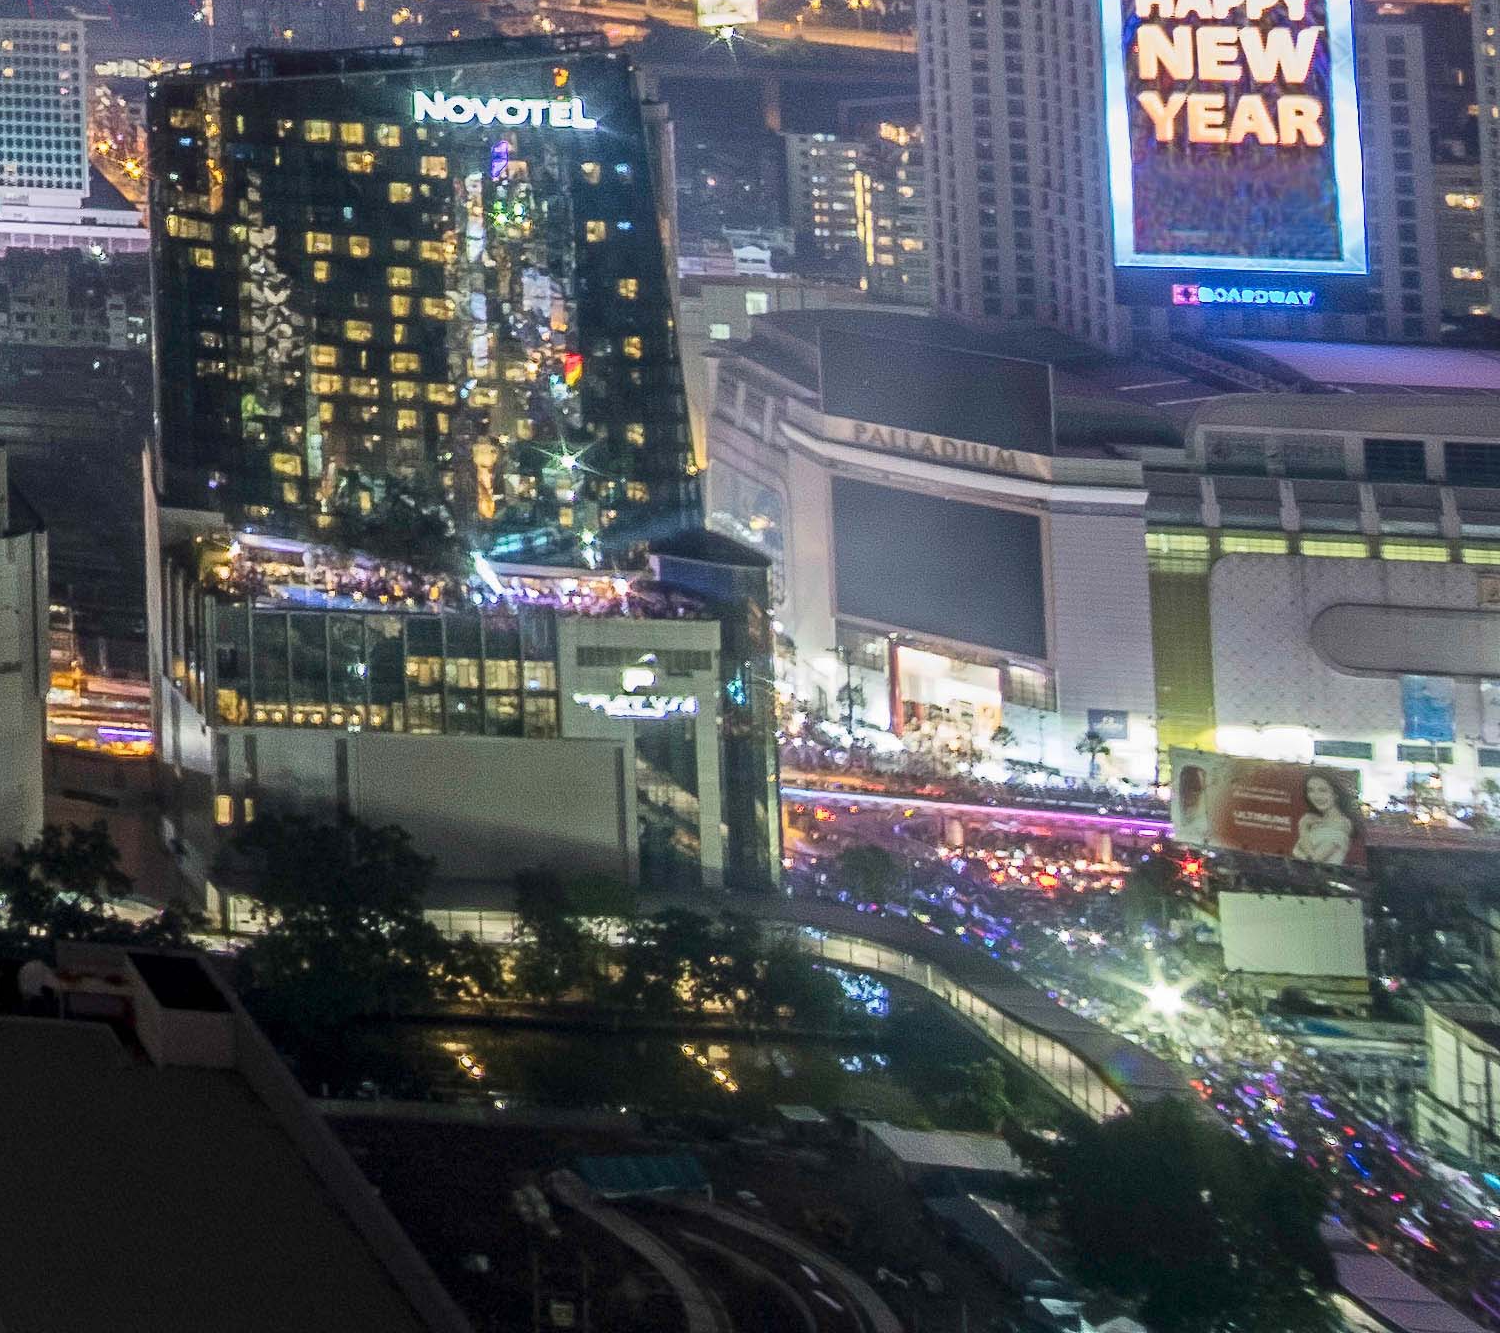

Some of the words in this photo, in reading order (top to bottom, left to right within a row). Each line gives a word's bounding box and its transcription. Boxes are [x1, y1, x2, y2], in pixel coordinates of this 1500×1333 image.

[1137, 24, 1325, 83] NEW
[412, 90, 598, 130] NOVOTEL
[1138, 90, 1325, 147] YEAR
[852, 422, 1019, 473] PALLADIUM
